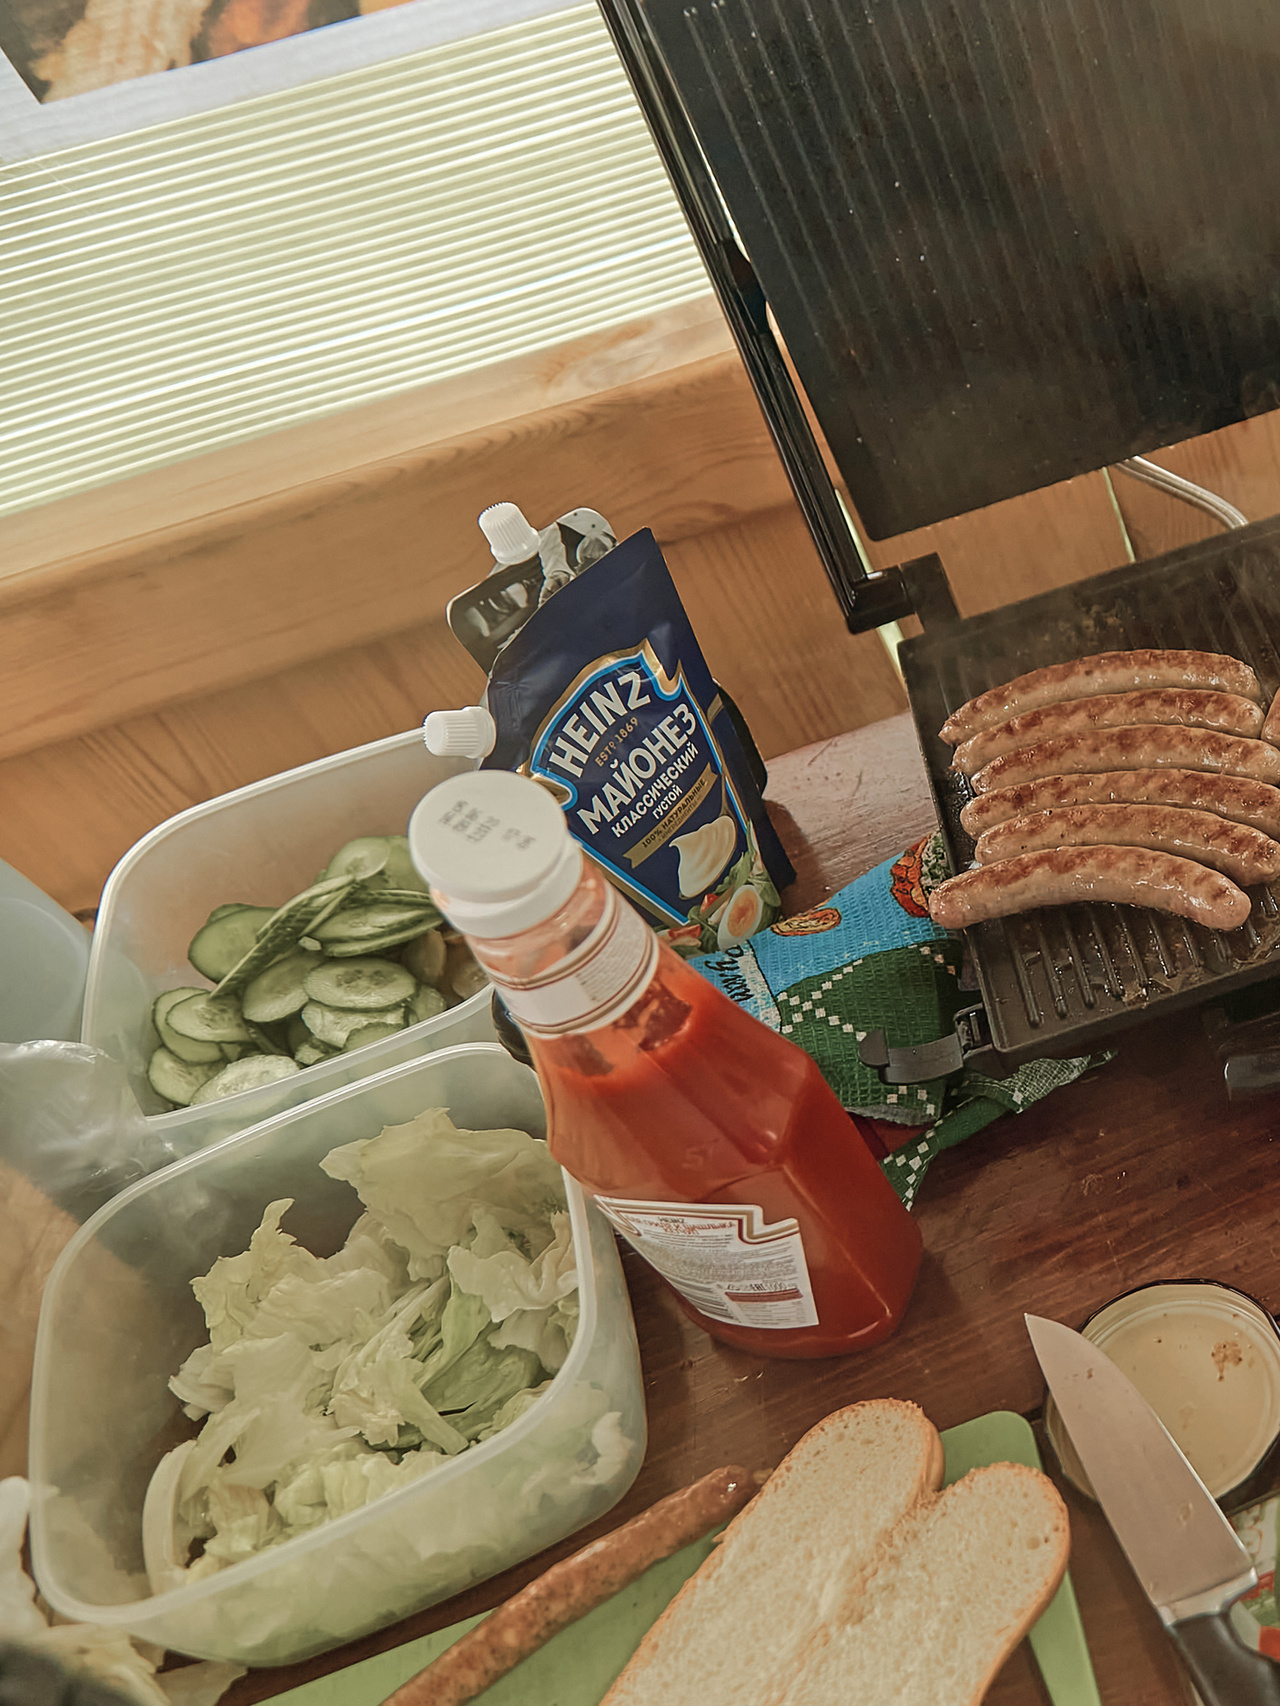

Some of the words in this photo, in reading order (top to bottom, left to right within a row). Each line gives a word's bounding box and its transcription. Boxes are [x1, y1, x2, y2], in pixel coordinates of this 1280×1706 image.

[549, 671, 651, 779] HEINZ
[614, 716, 639, 744] 1869
[576, 703, 697, 835] МАЙОНЕЗ
[611, 741, 699, 838] КЛАССИЧЕСКИЙ
[652, 784, 684, 820] ГУСТОЙ
[641, 828, 663, 849] 100%
[662, 778, 708, 830] НАТУРАЛЬНЫЕ
